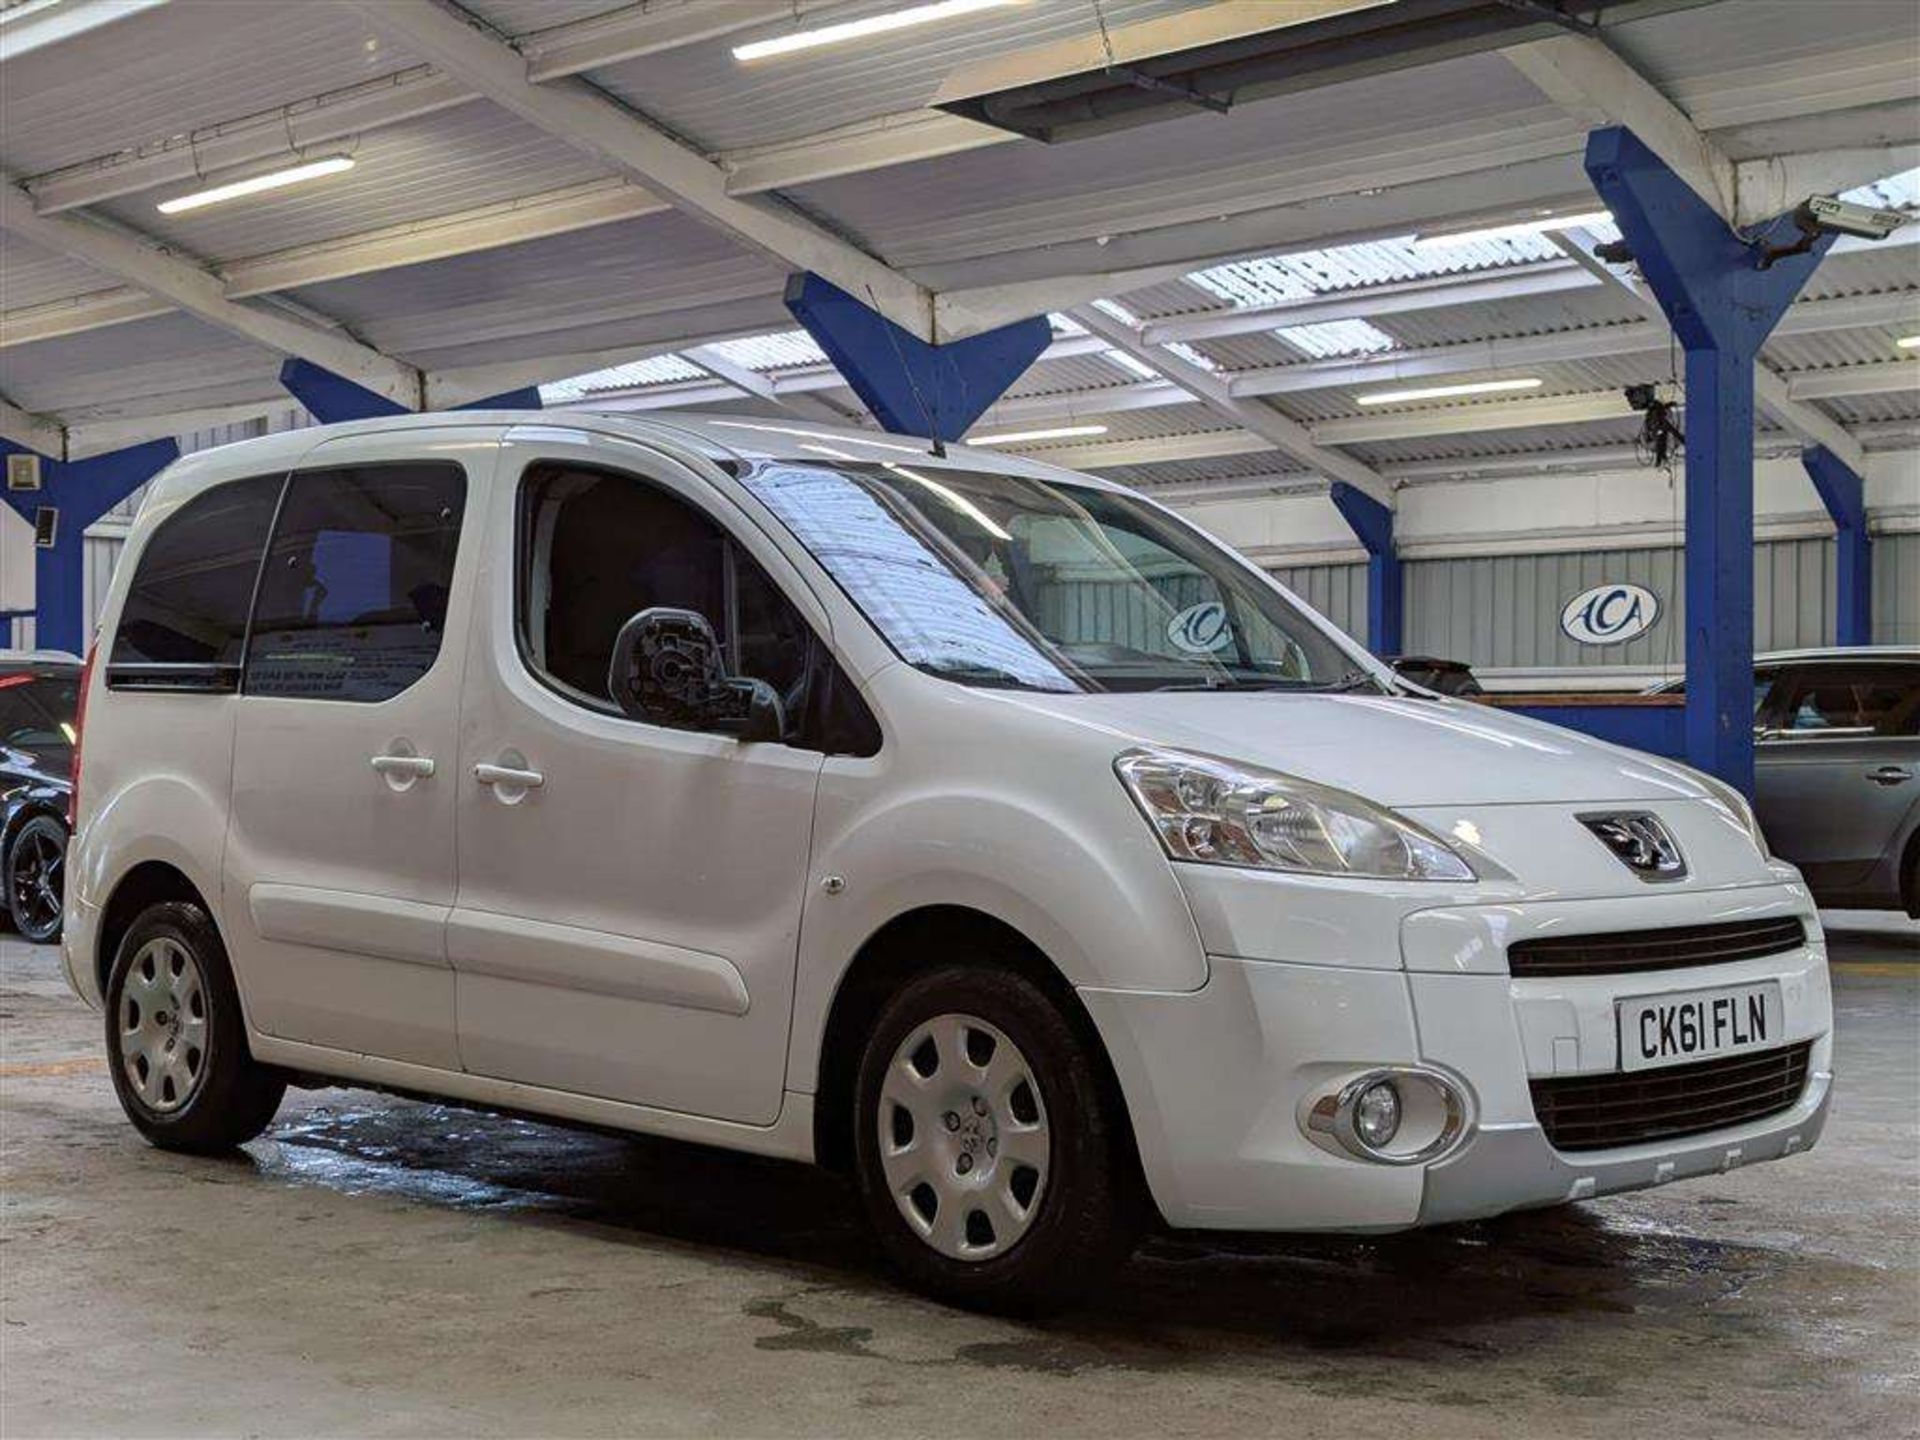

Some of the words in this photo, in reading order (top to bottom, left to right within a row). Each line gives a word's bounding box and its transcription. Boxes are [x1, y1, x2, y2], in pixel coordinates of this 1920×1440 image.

[1568, 590, 1643, 636] ACA
[1640, 1001, 1705, 1059] CK61
[1713, 993, 1766, 1048] FLN
